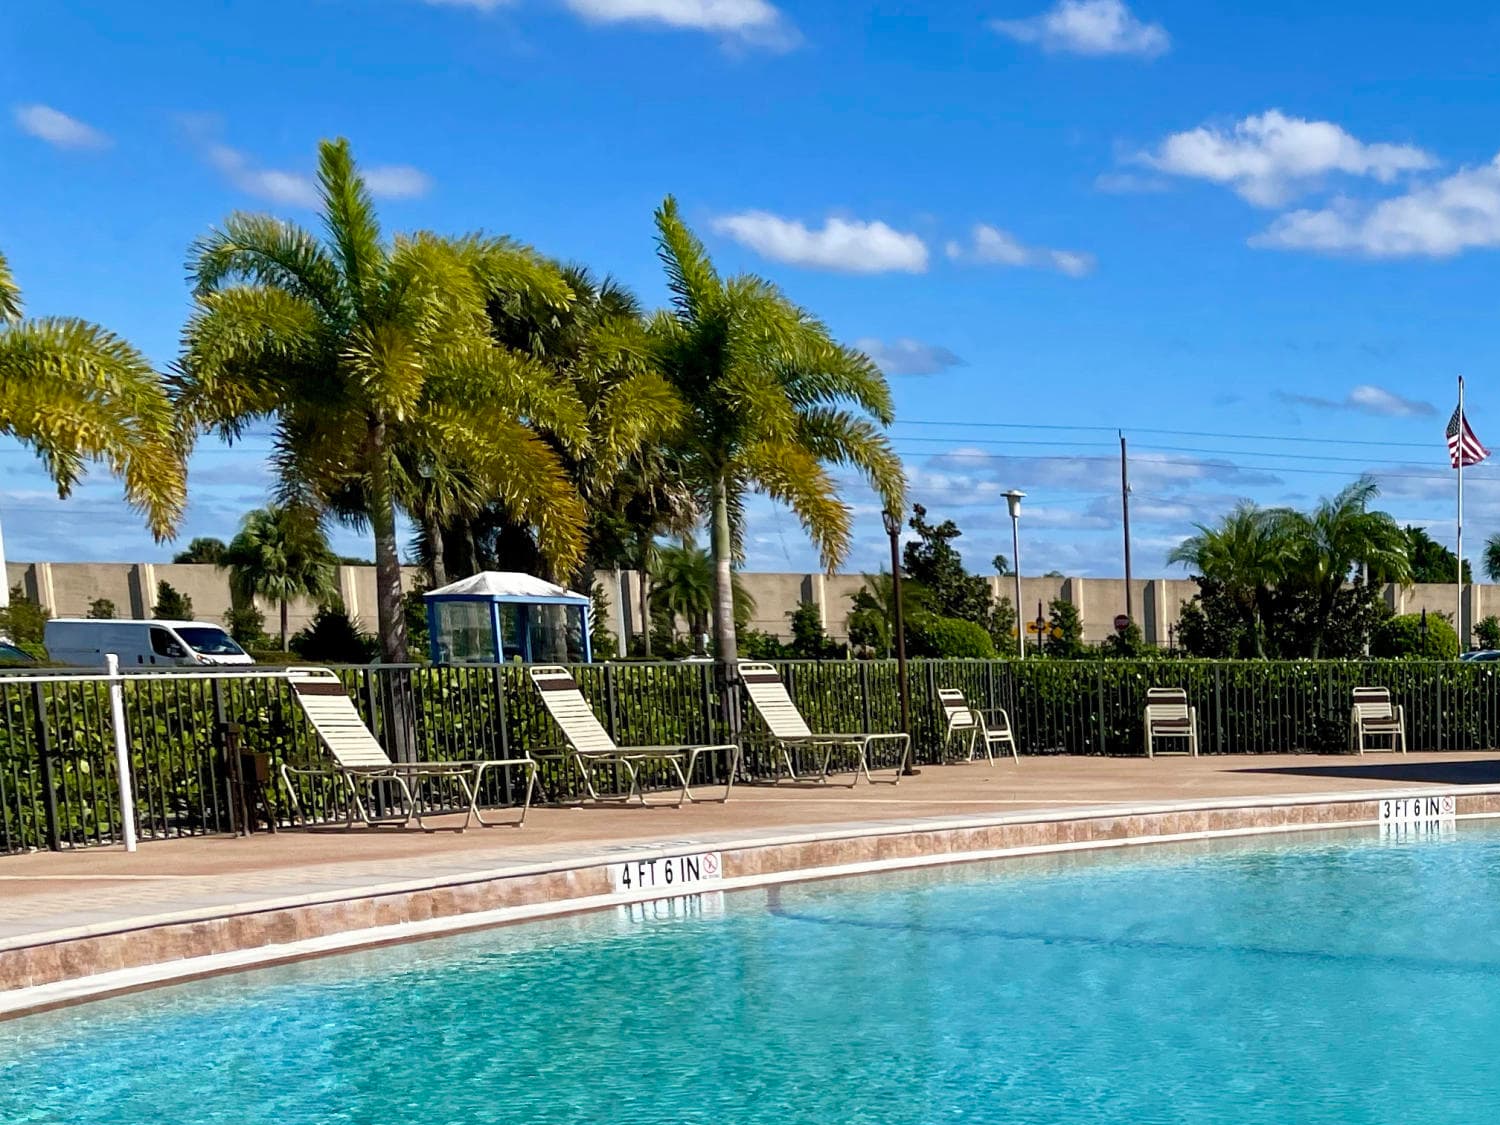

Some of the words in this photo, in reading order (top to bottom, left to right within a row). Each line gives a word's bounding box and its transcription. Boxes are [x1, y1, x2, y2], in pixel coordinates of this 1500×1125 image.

[1384, 801, 1391, 818] 3
[1395, 800, 1409, 817] FT
[1414, 799, 1420, 816] 6
[1425, 797, 1439, 816] IN
[622, 863, 631, 889] 4
[638, 860, 657, 887] FT
[665, 859, 673, 885] 6
[681, 855, 700, 882] IN
